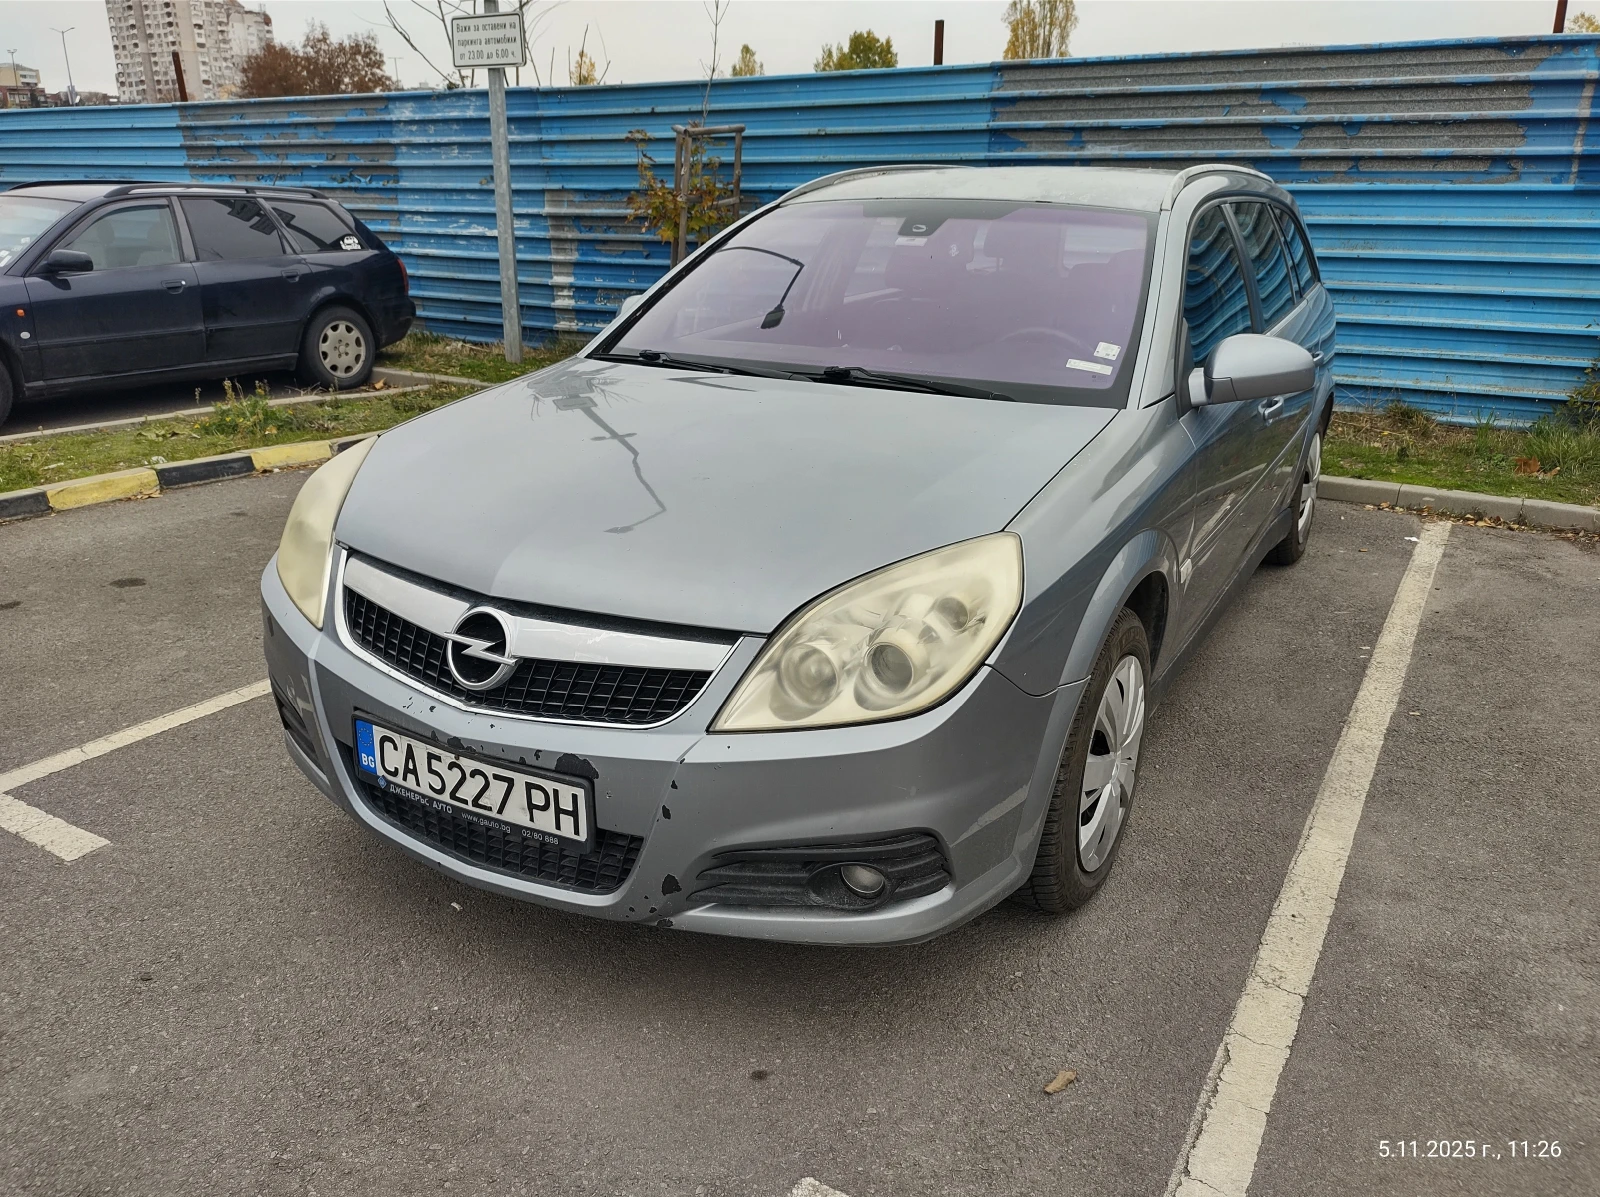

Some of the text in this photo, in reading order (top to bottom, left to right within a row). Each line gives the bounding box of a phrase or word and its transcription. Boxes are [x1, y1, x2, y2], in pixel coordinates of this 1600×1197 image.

[456, 21, 516, 33] Важи за оставени на
[457, 34, 516, 47] паркинга автомобили
[486, 51, 493, 59] до
[361, 753, 376, 768] BG
[432, 801, 453, 814] АУТО
[524, 780, 580, 837] PH
[461, 812, 511, 834] www.gauto.bg
[521, 829, 543, 841] 02/80
